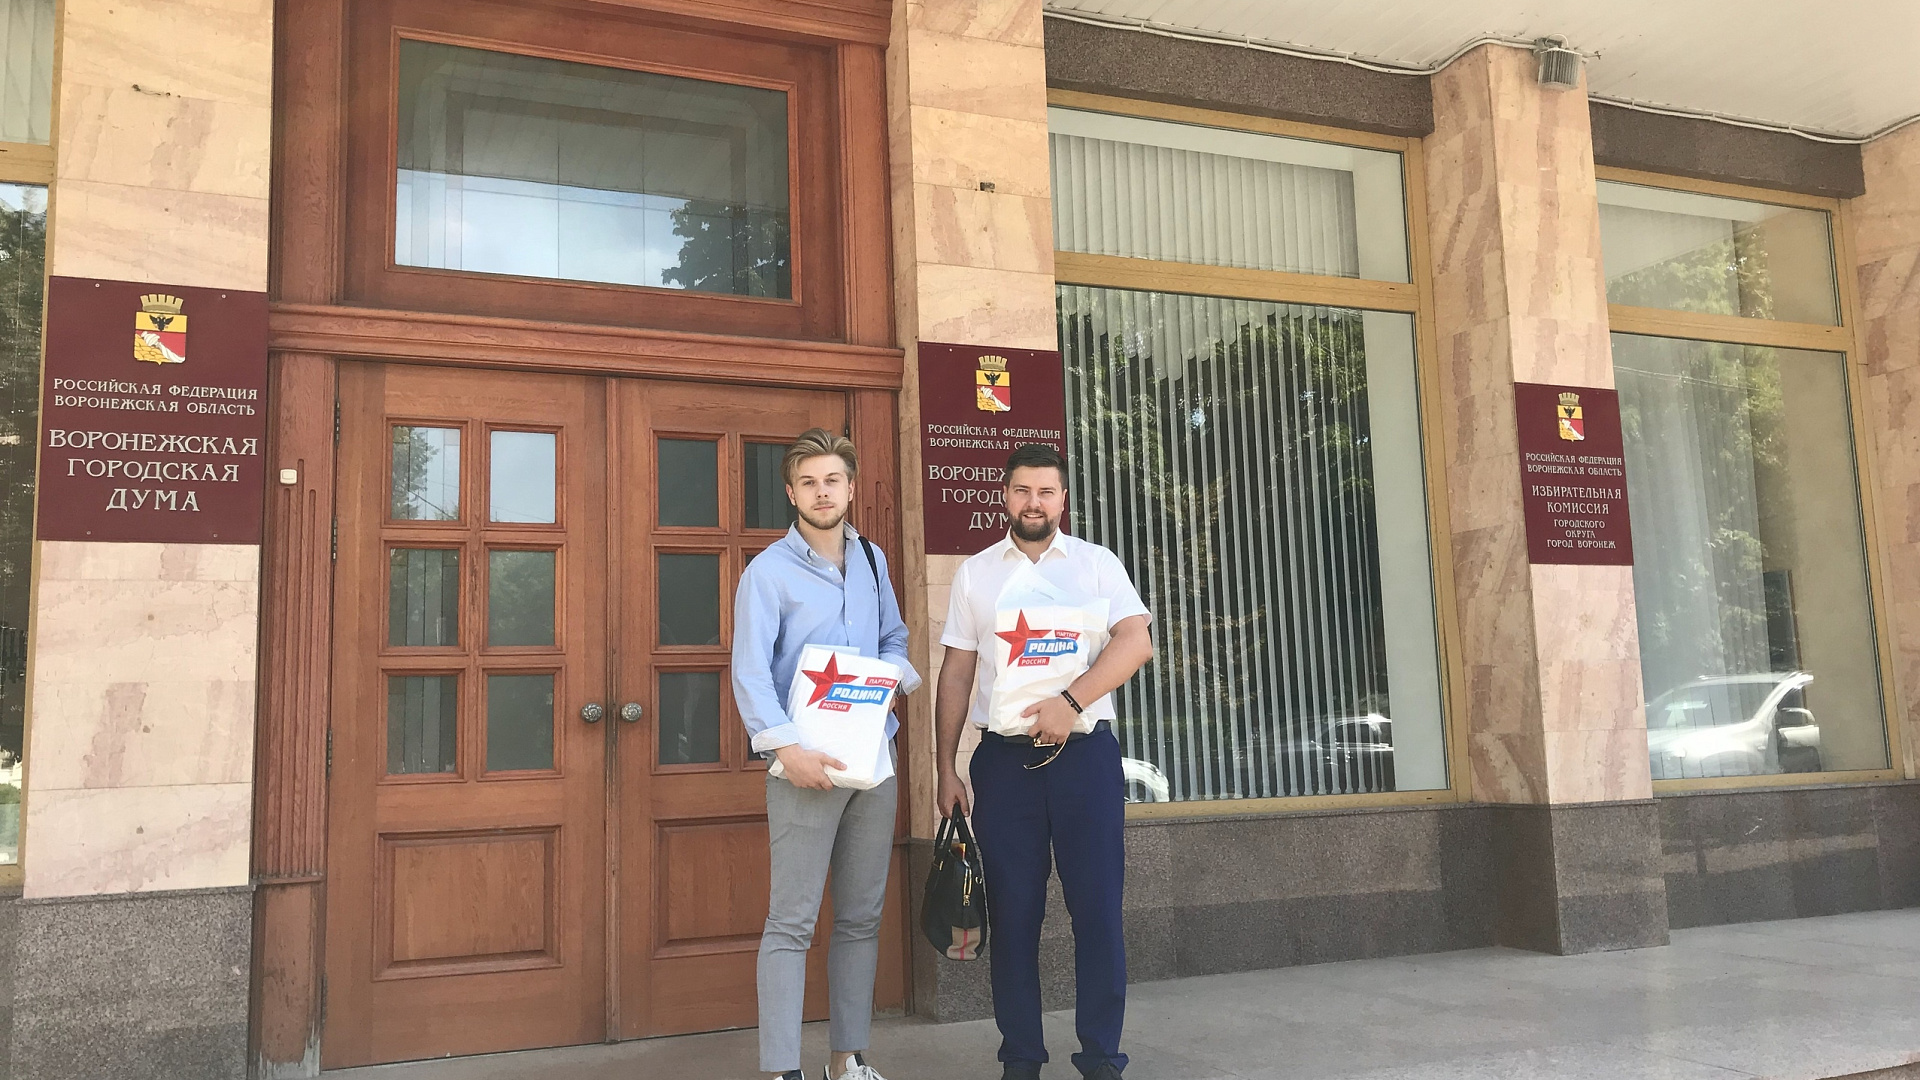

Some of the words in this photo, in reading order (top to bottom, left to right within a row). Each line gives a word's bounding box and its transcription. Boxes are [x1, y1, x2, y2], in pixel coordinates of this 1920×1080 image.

[54, 378, 161, 396] РОССИЙСКАЯ
[168, 384, 258, 400] ФЕДЕРАЦИЯ
[54, 395, 179, 413] ВОРОНЕЖСКАЯ
[186, 402, 255, 416] ОБЛАСТЬ
[928, 423, 997, 437] РОССИЙСКАЯ
[1002, 428, 1061, 439] ФЕДЕРАЦИЯ
[48, 429, 258, 456] ВОРОНЕЖСКАЯ
[930, 438, 1009, 450] ВОРОНЕЖСКАЯ
[1525, 452, 1576, 463] РОССИЙСКАЯ
[1578, 456, 1622, 466] ФЕДЕРАЦИЯ
[67, 458, 239, 483] ГОРОДСКАЯ
[928, 465, 1006, 482] ВОРОНЕ
[1527, 464, 1585, 475] ВОРОНЕЖСКАЯ
[1587, 468, 1622, 476] ОБЛАСТЬ
[941, 488, 1006, 507] ГОРОД
[1532, 485, 1622, 499] ИЗБИРАТЕЛЬНАЯ
[105, 488, 200, 512] ДУМА
[1546, 501, 1609, 514] КОМИССИЯ
[968, 511, 1009, 531] ДУМ
[1554, 519, 1606, 529] ГОРОДСКОГО
[1565, 529, 1596, 539] ОКРУГА
[1547, 539, 1574, 548] ГОРОД
[1577, 540, 1616, 549] ВОРОНЕЖ
[868, 678, 894, 687] ПАРТИЯ
[831, 687, 884, 701] РОДИНА
[821, 702, 848, 710] РОССИЯ
